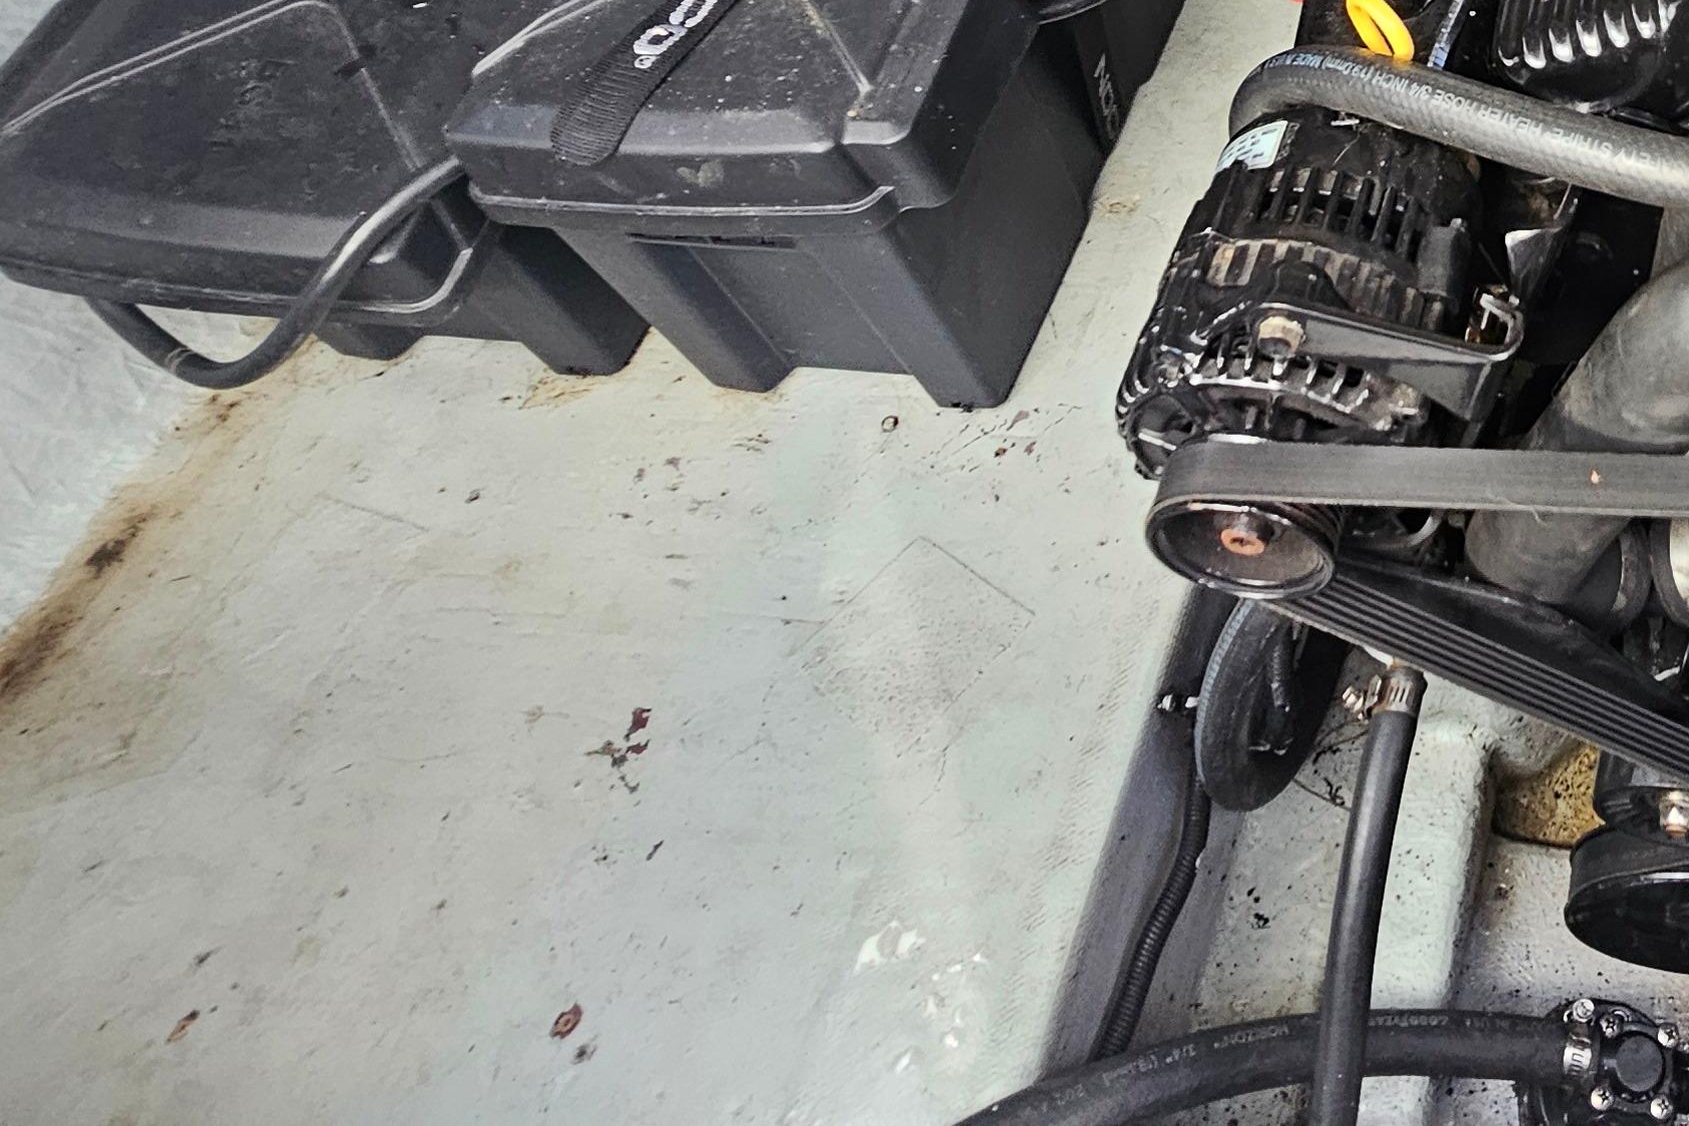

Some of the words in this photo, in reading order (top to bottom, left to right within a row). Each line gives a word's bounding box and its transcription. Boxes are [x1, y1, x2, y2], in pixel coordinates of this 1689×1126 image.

[1372, 72, 1410, 95] INCH
[1432, 93, 1477, 116] HOSE
[1477, 106, 1544, 139] HEATER
